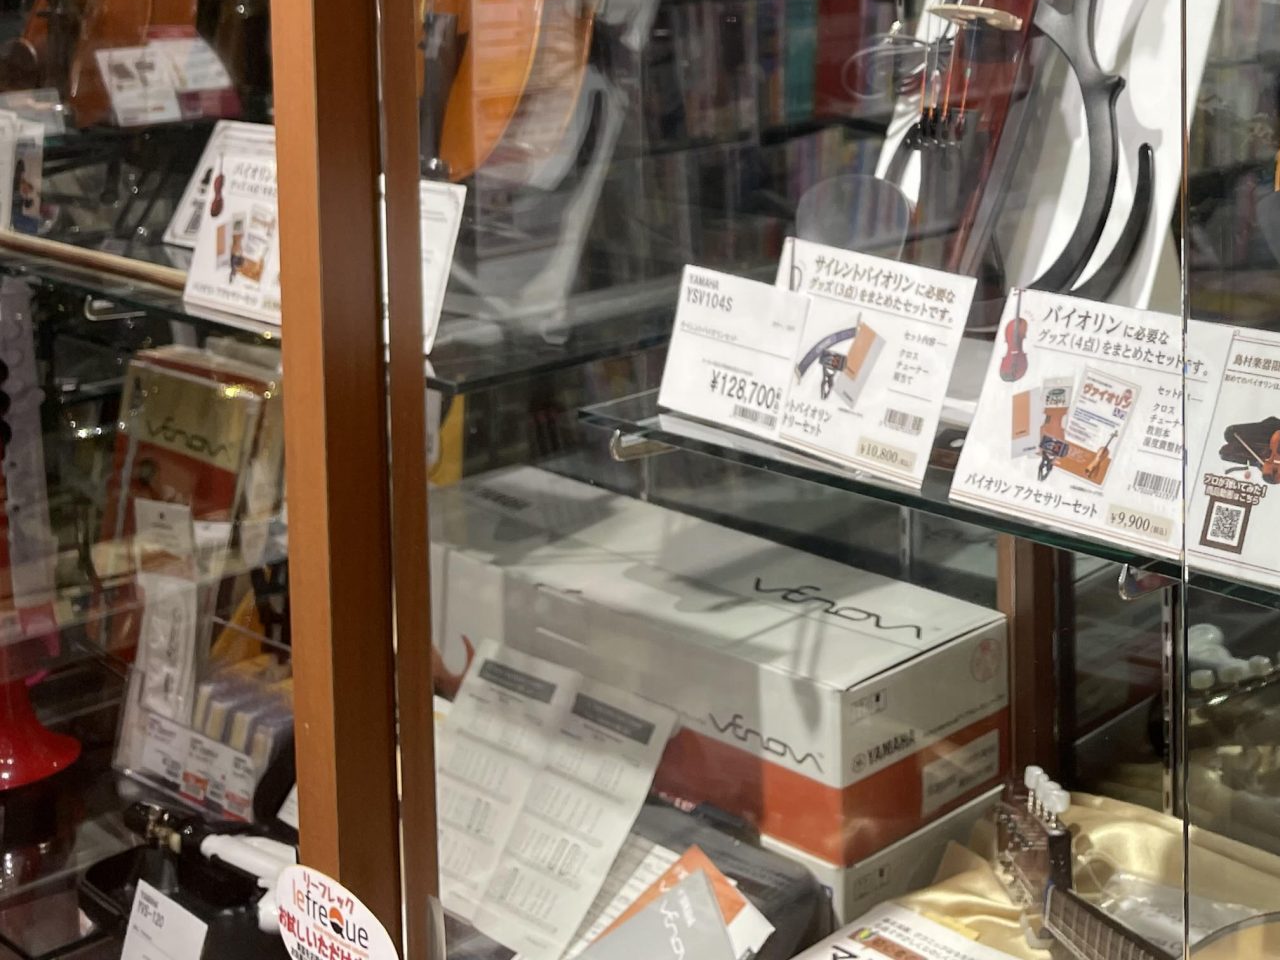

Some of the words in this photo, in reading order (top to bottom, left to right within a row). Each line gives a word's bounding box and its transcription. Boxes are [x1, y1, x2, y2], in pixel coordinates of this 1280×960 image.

[687, 286, 733, 312] YSV104S
[711, 369, 775, 409] ¥128,700
[1150, 414, 1183, 428] チューナ
[964, 472, 1011, 494] バイオリン
[1110, 511, 1150, 532] ¥9,900
[303, 871, 355, 915] リーフレック
